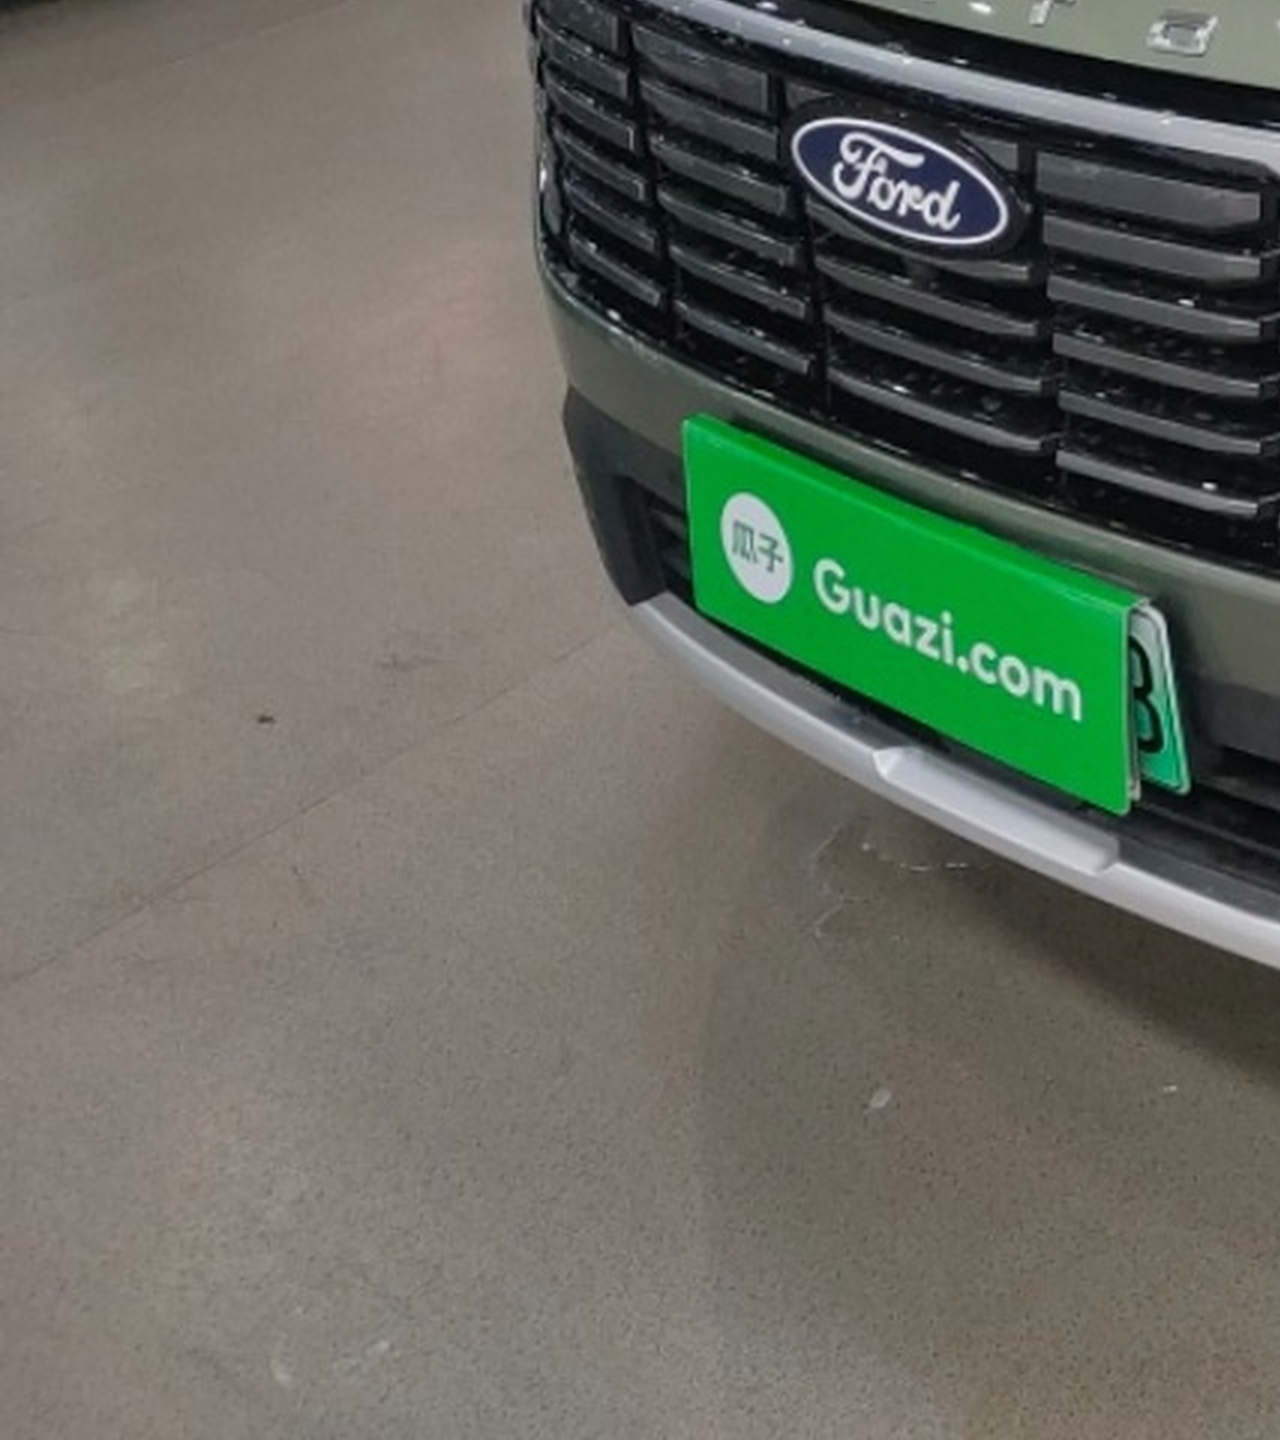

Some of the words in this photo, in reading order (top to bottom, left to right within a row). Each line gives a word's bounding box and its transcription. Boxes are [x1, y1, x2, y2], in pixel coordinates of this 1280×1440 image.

[832, 132, 961, 231] Ford
[732, 519, 784, 574] 瓜子
[813, 558, 1082, 722] Guazi.com
